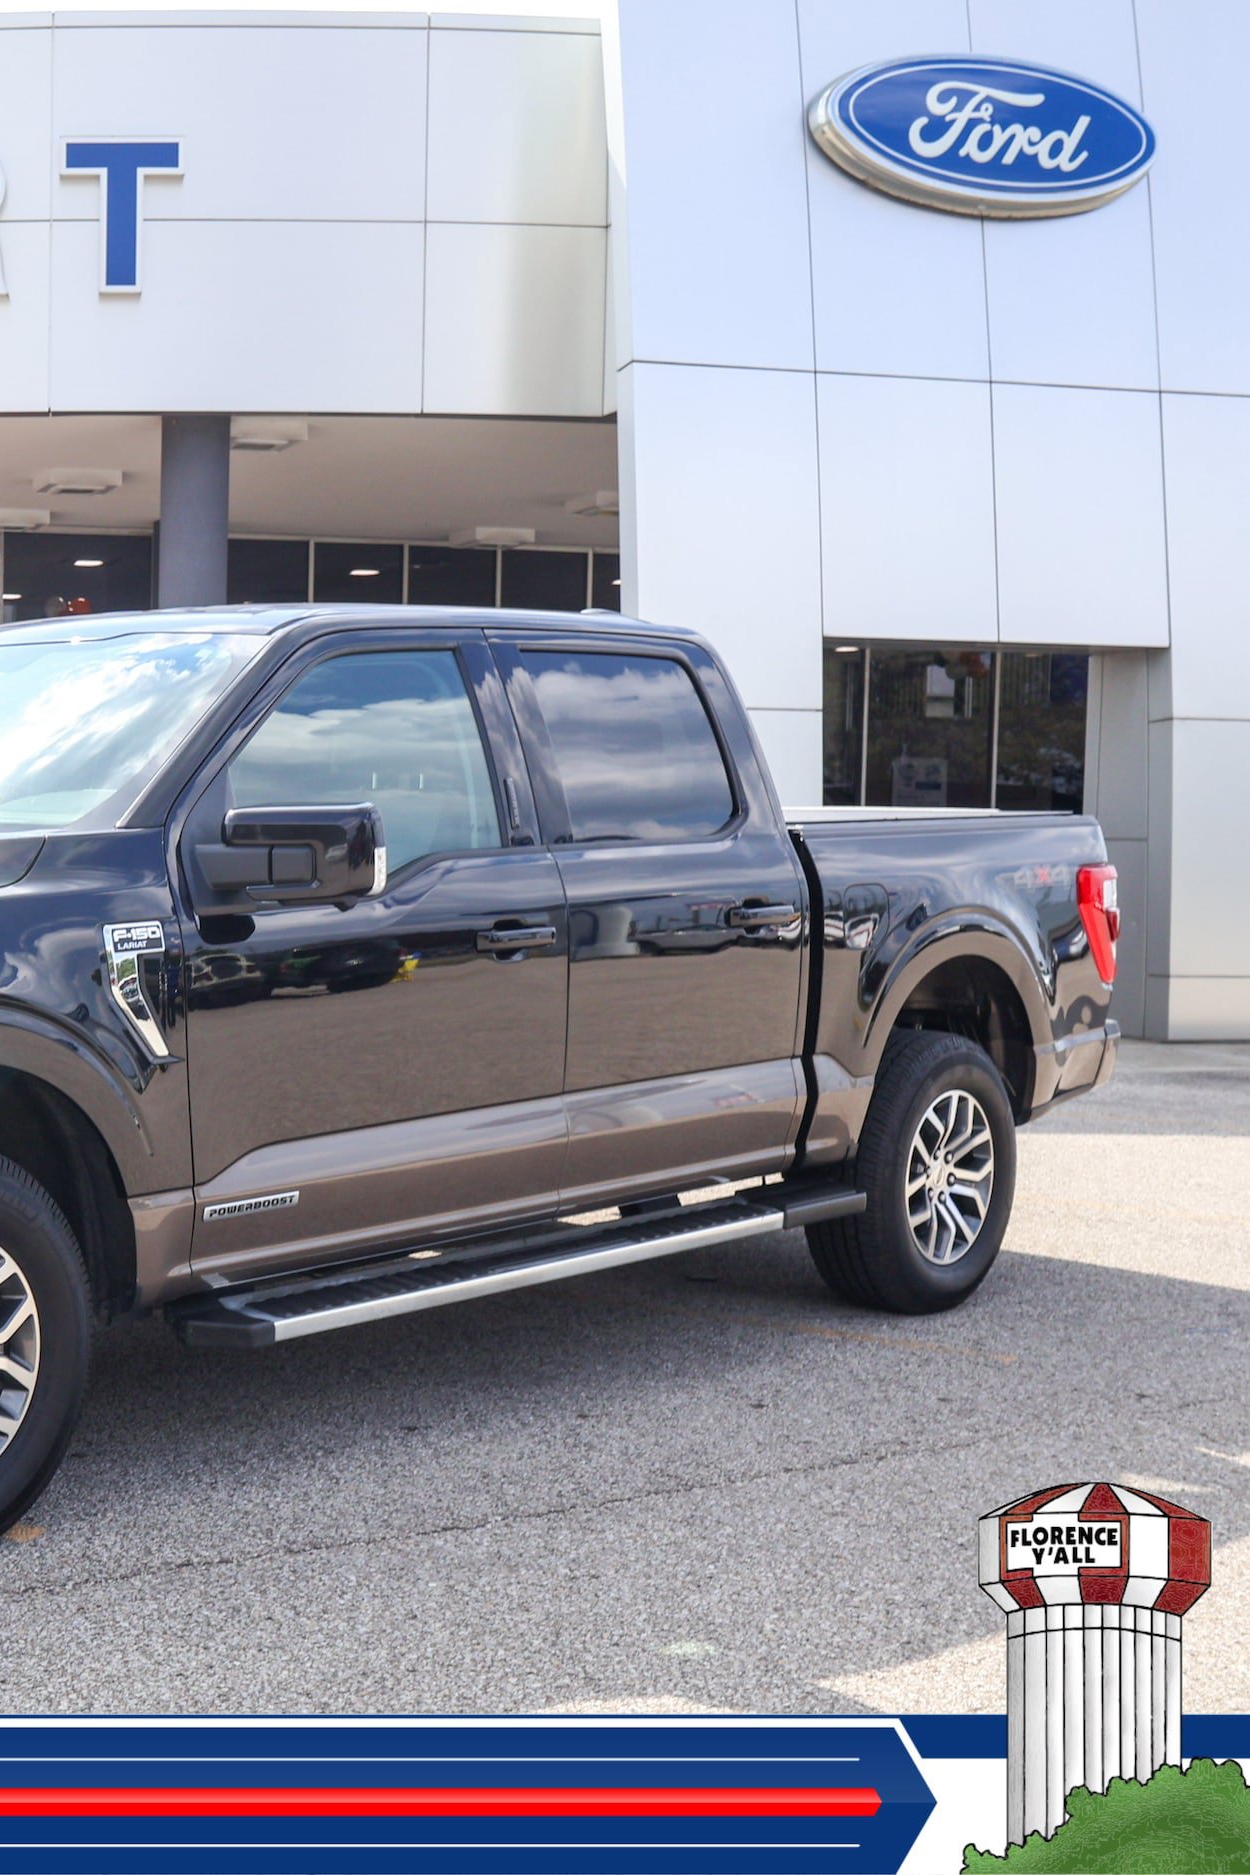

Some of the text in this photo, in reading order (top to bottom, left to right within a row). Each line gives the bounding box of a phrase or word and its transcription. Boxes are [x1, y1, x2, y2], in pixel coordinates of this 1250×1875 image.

[907, 80, 1092, 173] Ford
[113, 926, 160, 942] F-150
[117, 940, 148, 950] LARIAT
[209, 1195, 296, 1218] POWERBOOST
